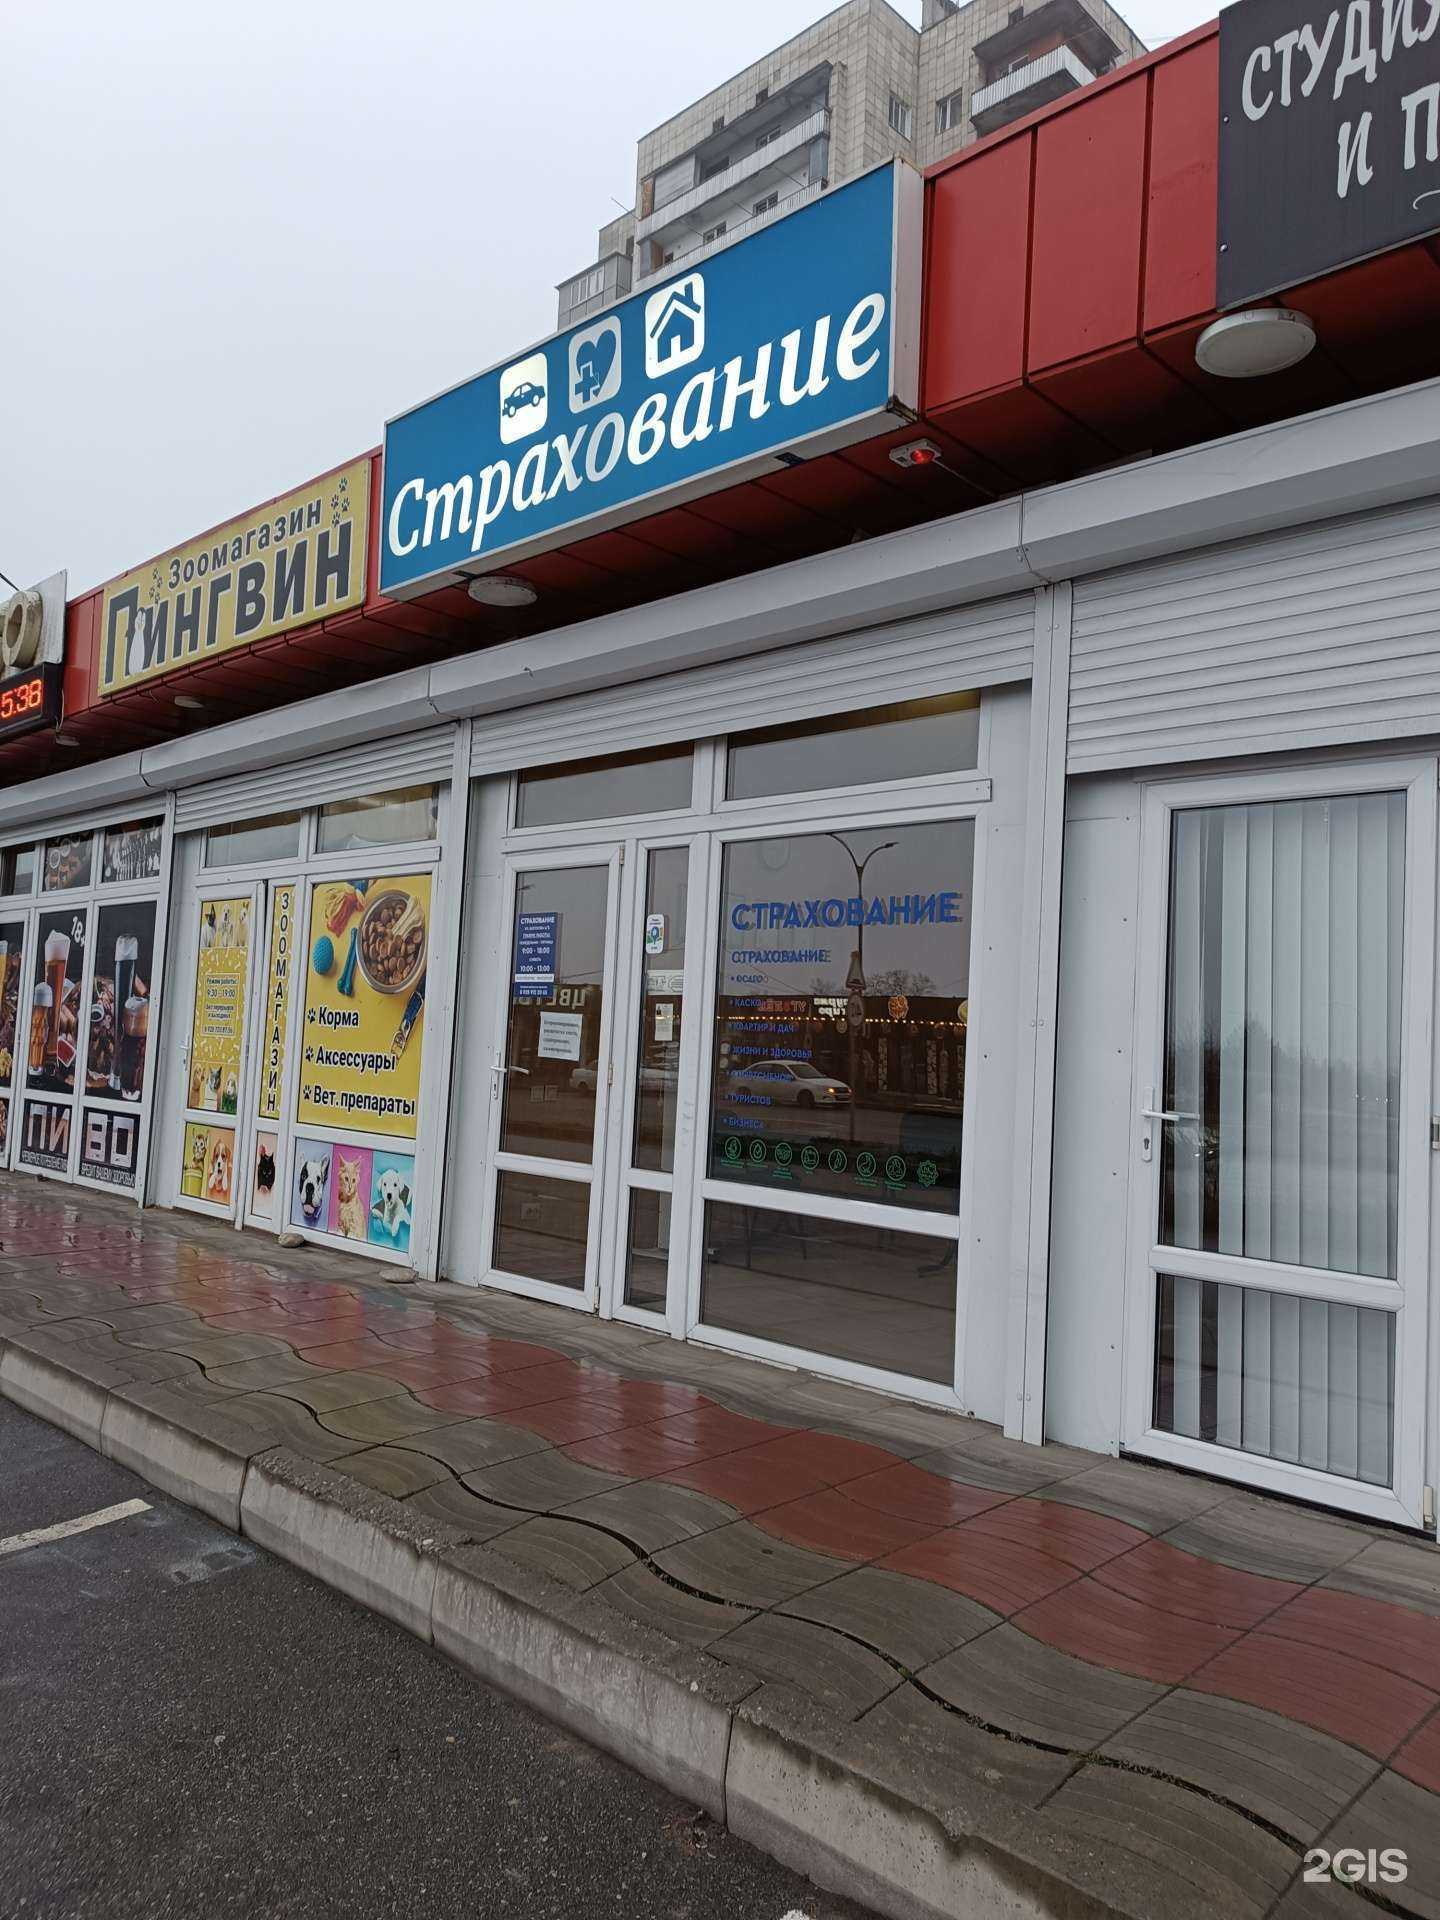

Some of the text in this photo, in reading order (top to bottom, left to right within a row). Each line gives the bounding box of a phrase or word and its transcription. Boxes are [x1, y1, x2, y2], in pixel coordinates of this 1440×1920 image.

[1337, 111, 1373, 199] И
[388, 292, 886, 557] Страхование
[168, 499, 322, 590] Зоомагазин
[731, 891, 963, 931] СТРАХОВАНИЕ
[266, 892, 290, 1112] ЗООМАГАЗИН
[318, 1006, 360, 1031] Корма
[315, 1045, 396, 1074] Аксессуары
